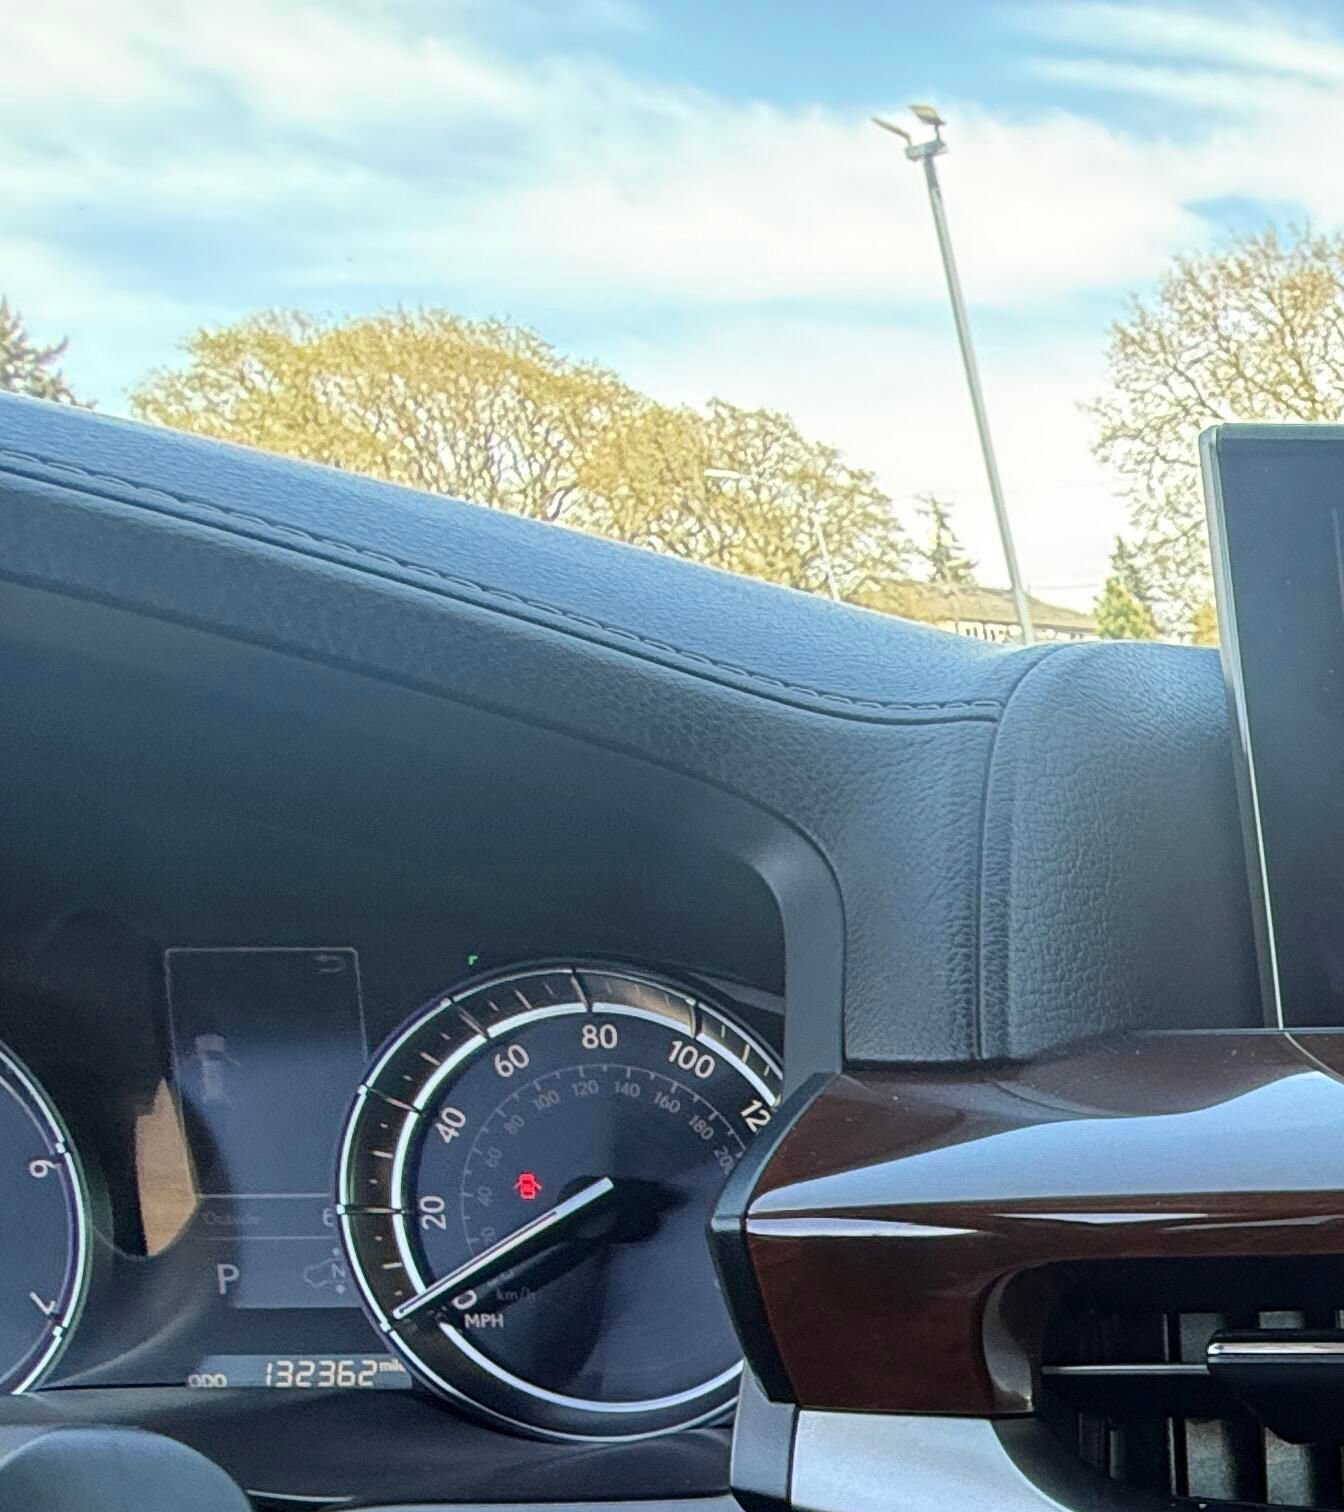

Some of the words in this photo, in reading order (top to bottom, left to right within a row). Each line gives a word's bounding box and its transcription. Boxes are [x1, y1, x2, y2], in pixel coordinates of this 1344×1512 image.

[581, 1023, 619, 1050] 80
[493, 1044, 531, 1079] 60
[667, 1039, 716, 1080] 100
[571, 1079, 600, 1097] 120
[613, 1079, 641, 1099] 140
[434, 1106, 467, 1144] 40
[740, 1099, 773, 1134] 12
[419, 1195, 447, 1232] 20
[216, 1263, 240, 1296] P
[464, 1313, 504, 1329] MPH
[188, 1373, 228, 1388] ODO
[265, 1359, 378, 1388] 132362
